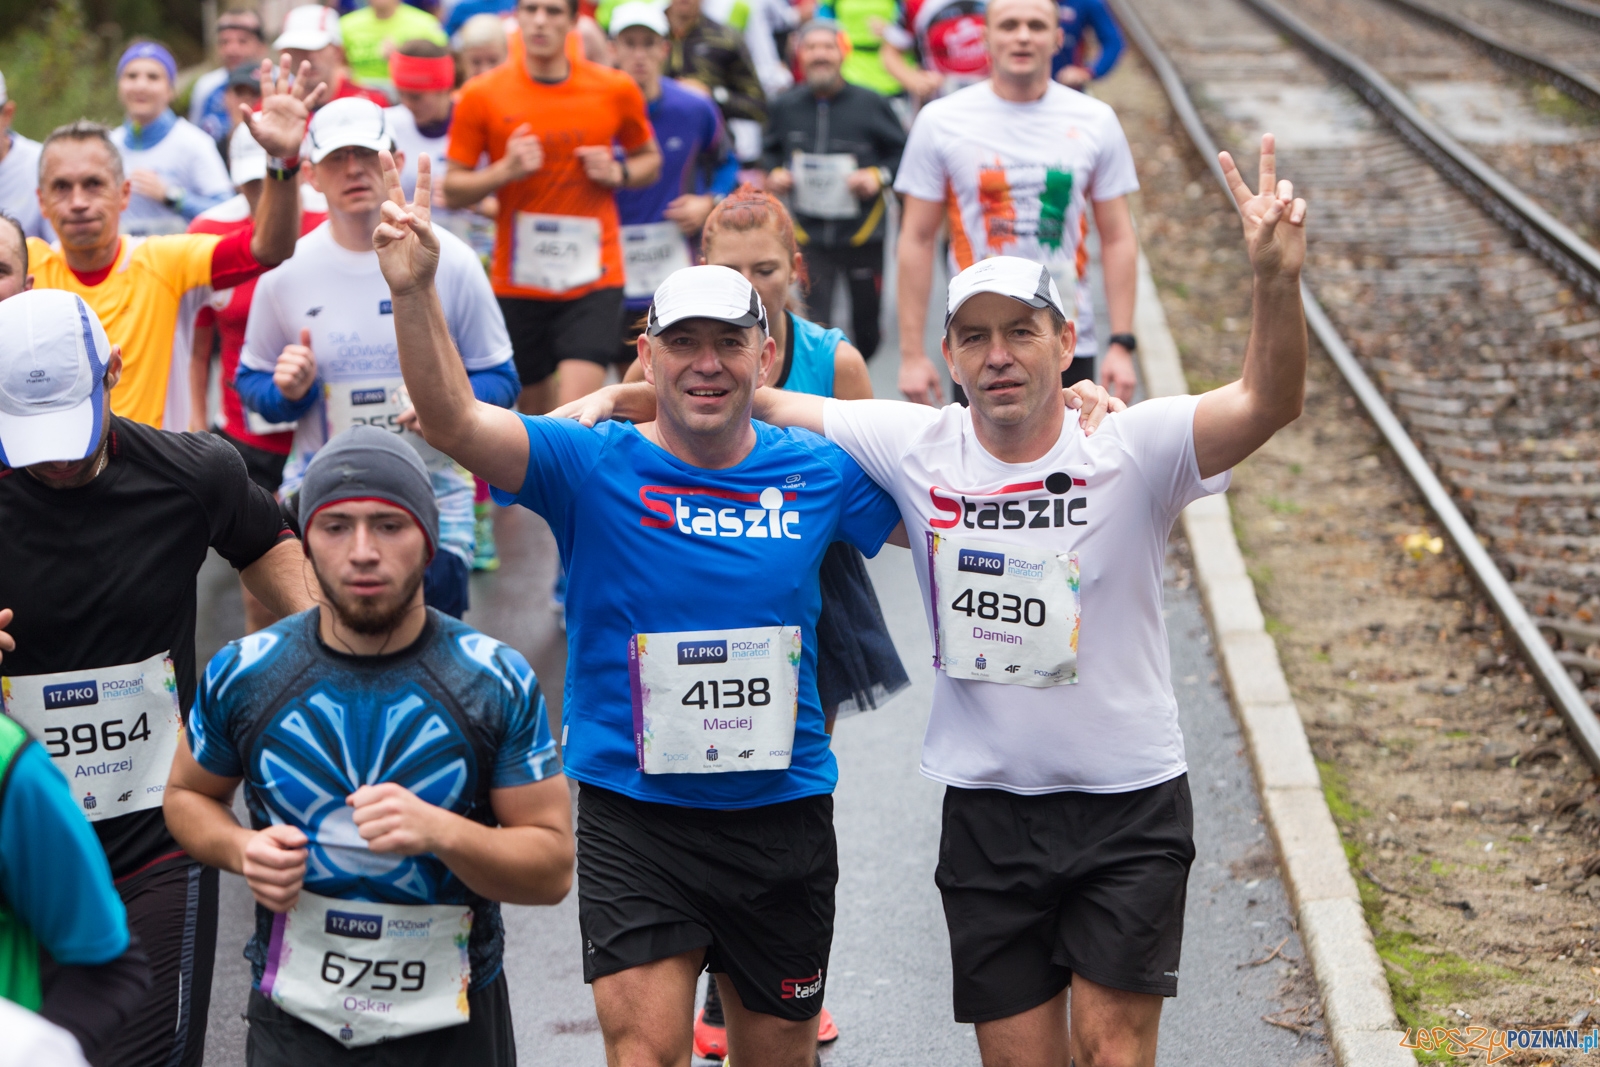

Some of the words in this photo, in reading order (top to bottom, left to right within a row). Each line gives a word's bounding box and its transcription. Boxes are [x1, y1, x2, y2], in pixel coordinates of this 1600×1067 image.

[930, 472, 1088, 530] Staszic
[639, 485, 801, 540] Staszic
[1007, 567, 1043, 578] maraton
[951, 588, 1046, 627] 4830
[973, 627, 1022, 645] Damian
[732, 649, 770, 658] maraton
[103, 684, 144, 699] maraton
[681, 677, 771, 710] 4138
[703, 716, 753, 731] Maciej
[44, 712, 151, 758] 3964
[74, 756, 133, 778] Andrzej
[386, 928, 430, 939] maraton
[320, 951, 426, 992] 6759
[343, 996, 393, 1013] Oskar
